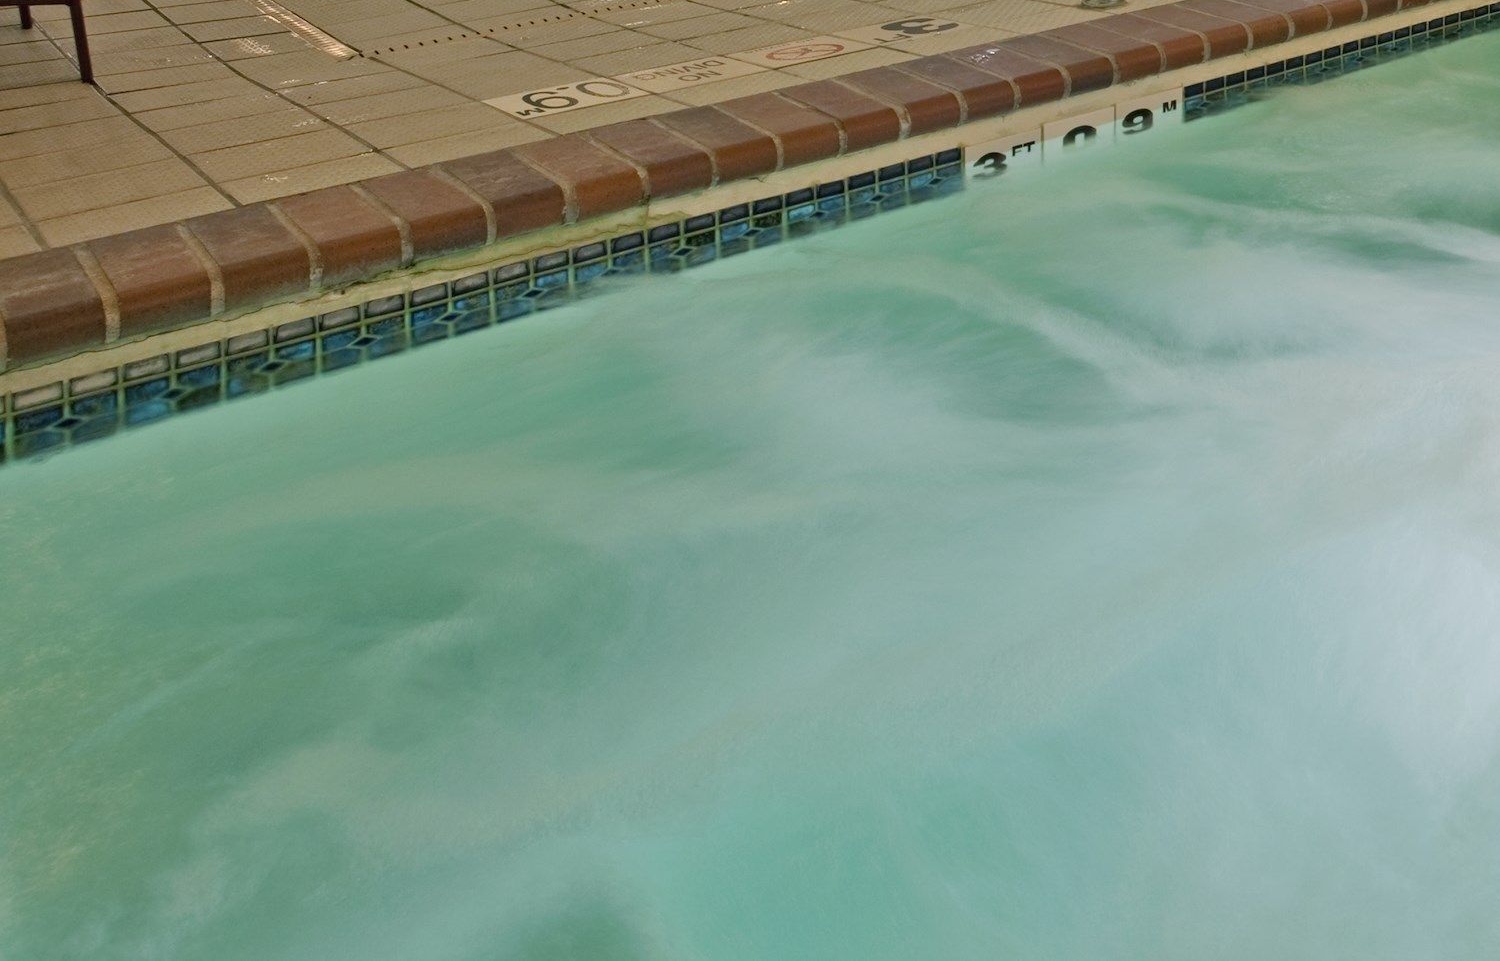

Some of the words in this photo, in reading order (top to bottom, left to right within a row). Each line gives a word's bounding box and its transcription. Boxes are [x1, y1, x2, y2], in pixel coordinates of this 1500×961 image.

[880, 17, 960, 36] 3
[874, 32, 912, 44] FT
[632, 59, 726, 81] DIVING
[678, 69, 719, 82] NO
[521, 80, 631, 109] 0.9
[515, 105, 546, 118] M
[973, 151, 1007, 178] 3
[1012, 141, 1036, 157] FT
[1122, 108, 1153, 135] 9
[1162, 100, 1177, 114] M
